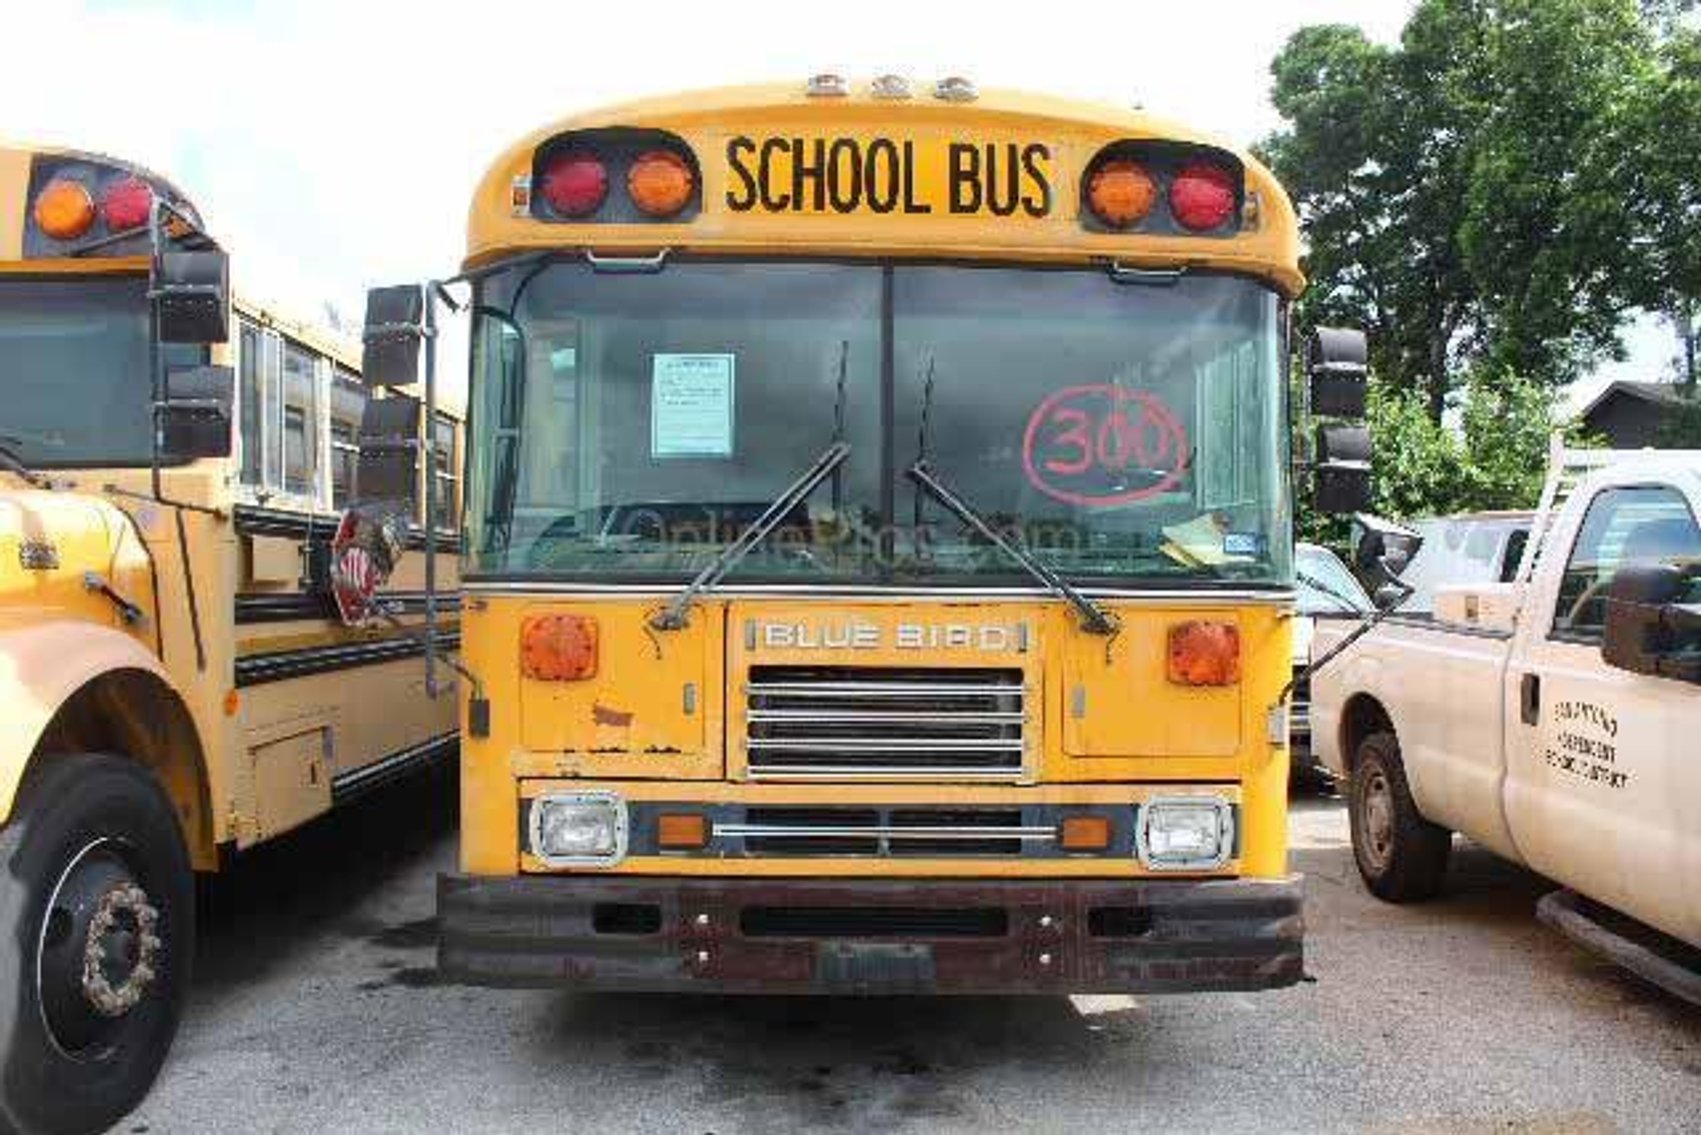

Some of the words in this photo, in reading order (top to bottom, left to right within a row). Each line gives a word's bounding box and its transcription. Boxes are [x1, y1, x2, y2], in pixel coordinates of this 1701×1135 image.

[726, 136, 931, 213] SCHOOL
[949, 143, 1051, 218] BUS
[1045, 408, 1169, 474] 300
[765, 624, 881, 649] BLUE
[896, 625, 1006, 651] BIRD
